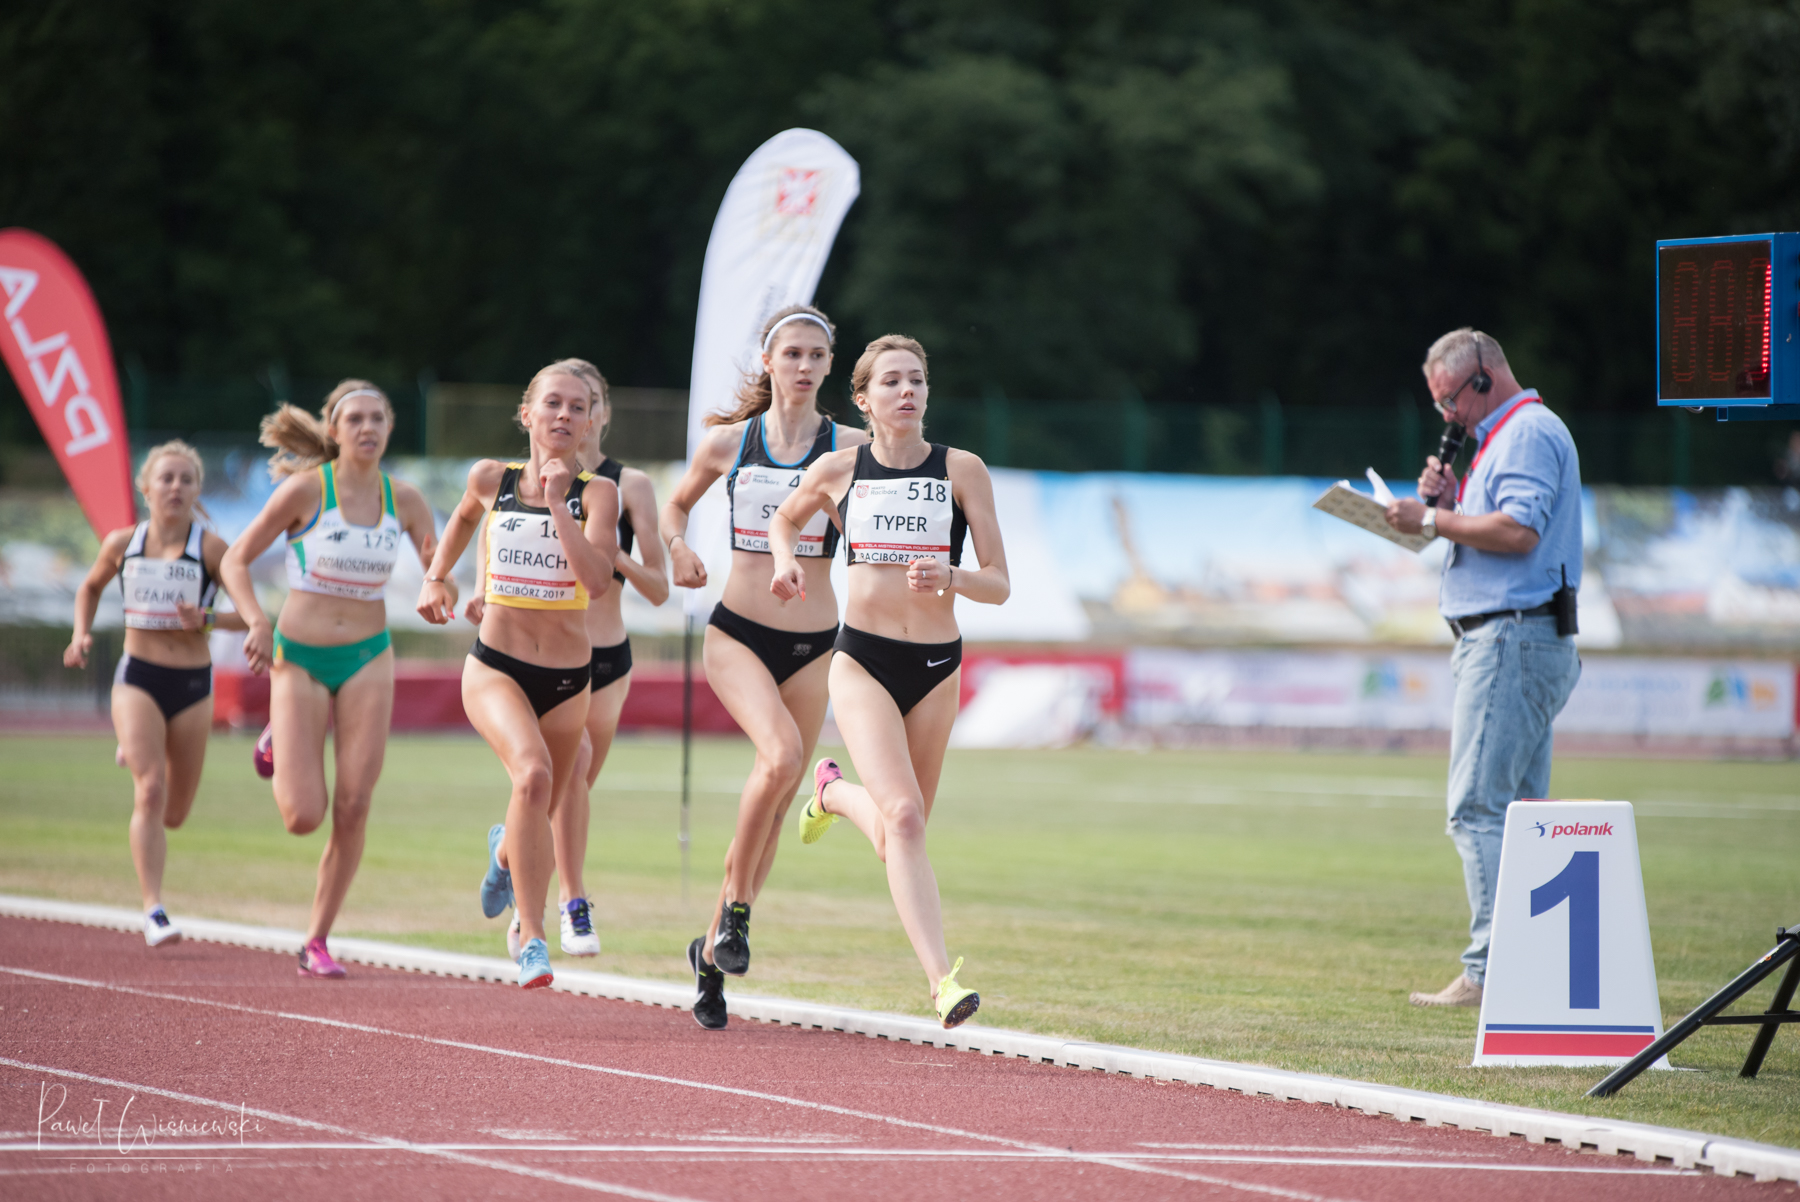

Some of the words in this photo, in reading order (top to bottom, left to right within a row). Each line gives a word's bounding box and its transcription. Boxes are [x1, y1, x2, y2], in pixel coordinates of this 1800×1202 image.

[907, 481, 947, 502] 518
[873, 514, 928, 533] TYPER
[498, 548, 568, 570] GIERACH
[494, 584, 540, 597] RACIBÓRZ
[543, 589, 565, 599] 2019
[1551, 822, 1614, 839] polanik
[1530, 851, 1600, 1010] 1
